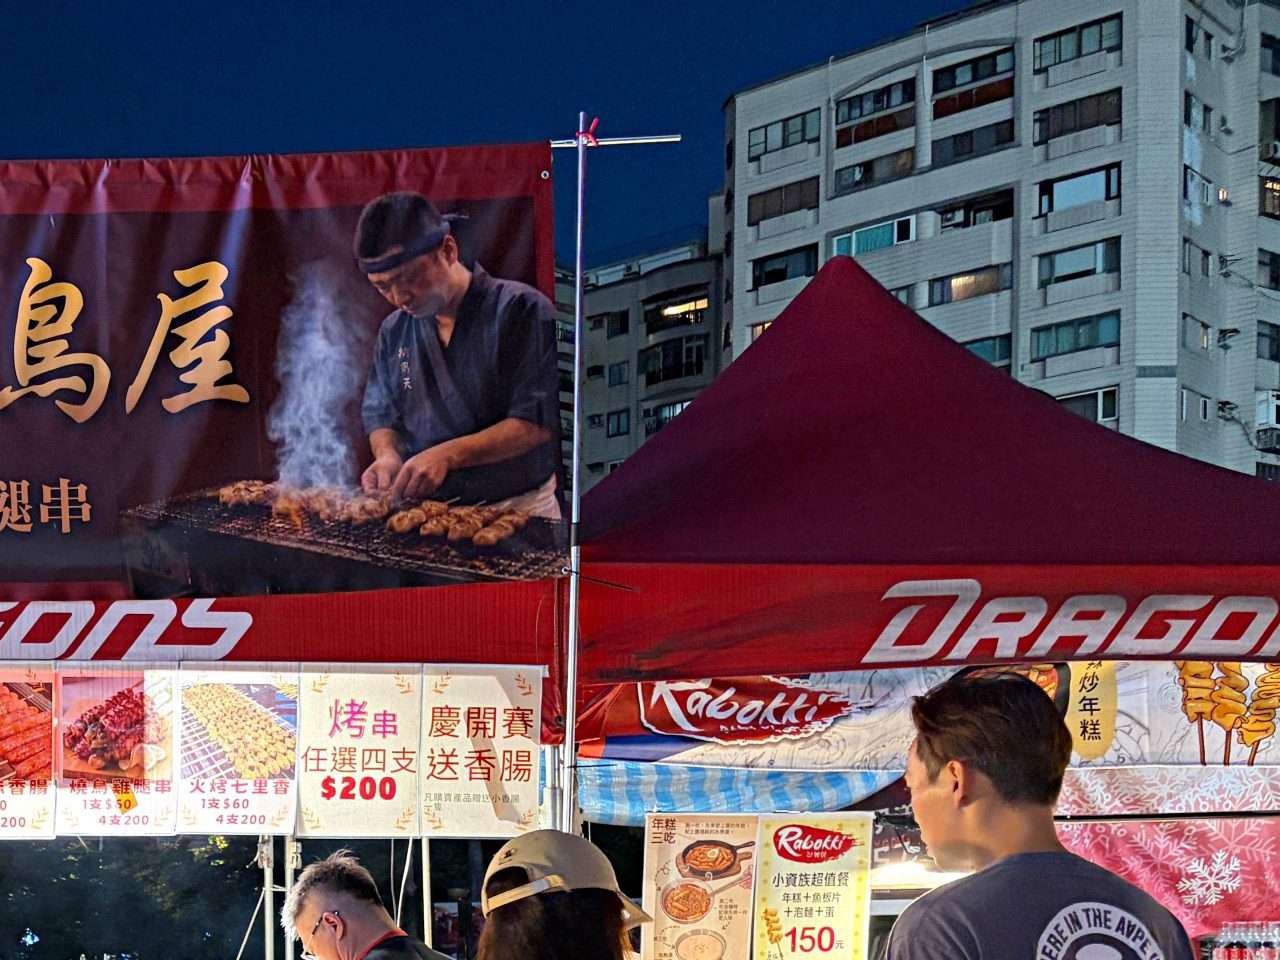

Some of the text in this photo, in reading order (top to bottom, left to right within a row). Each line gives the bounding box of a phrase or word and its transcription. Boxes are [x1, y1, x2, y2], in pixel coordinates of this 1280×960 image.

[328, 699, 398, 740] 烤串
[428, 705, 534, 740] 慶開賽
[301, 746, 417, 774] 任選四支
[426, 748, 533, 783] 送香腸
[70, 778, 171, 795] 燒鳥雞腿串
[189, 779, 290, 795] 火烤七里香
[321, 776, 397, 800] $200
[652, 817, 677, 831] 年糕
[651, 831, 677, 844] 三吃
[778, 826, 847, 858] Rabokki
[773, 872, 850, 887] 小資族超值餐
[784, 926, 835, 953] 150
